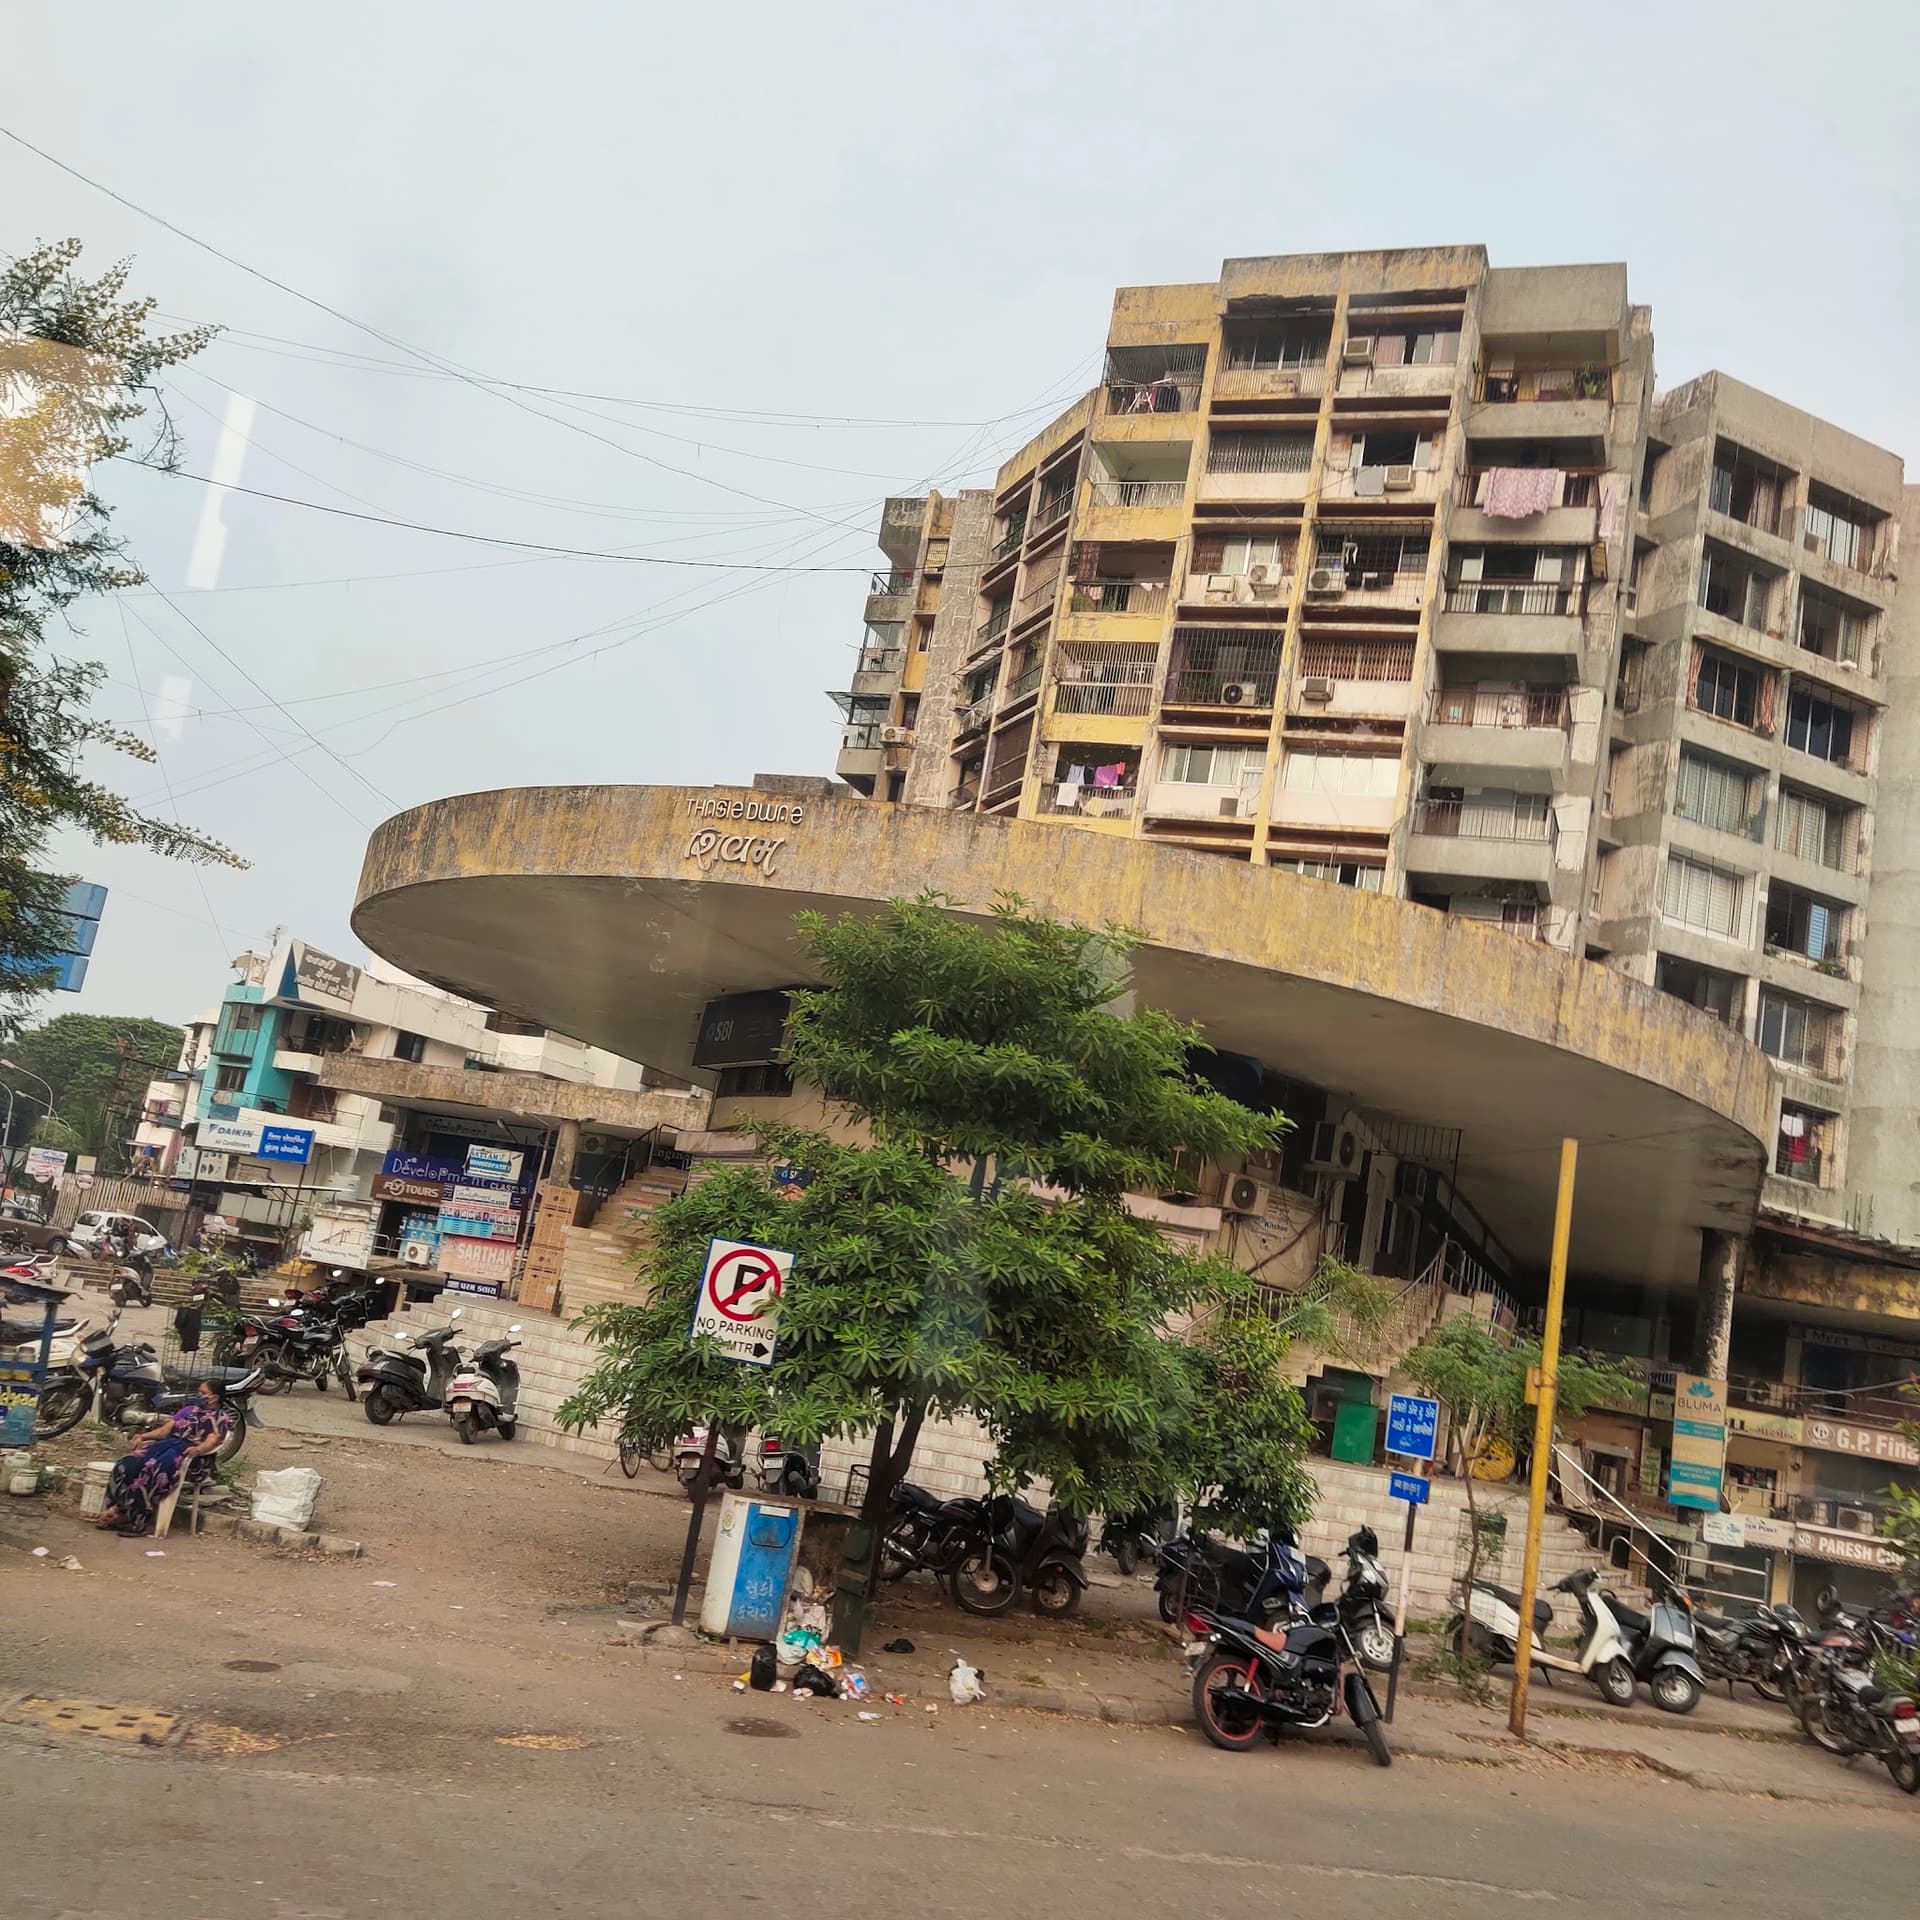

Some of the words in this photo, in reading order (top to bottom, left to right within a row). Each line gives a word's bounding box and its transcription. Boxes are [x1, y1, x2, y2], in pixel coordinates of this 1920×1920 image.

[714, 1020, 734, 1042] SBI
[217, 1127, 254, 1138] DAIKIN
[405, 1184, 440, 1198] TOURS
[457, 1244, 514, 1266] SARTHAK
[696, 1317, 716, 1330] NO
[718, 1320, 775, 1341] PARKING
[1678, 1397, 1721, 1413] BLUMA
[1837, 1428, 1871, 1453] G.P.
[1818, 1536, 1873, 1561] PARESH
